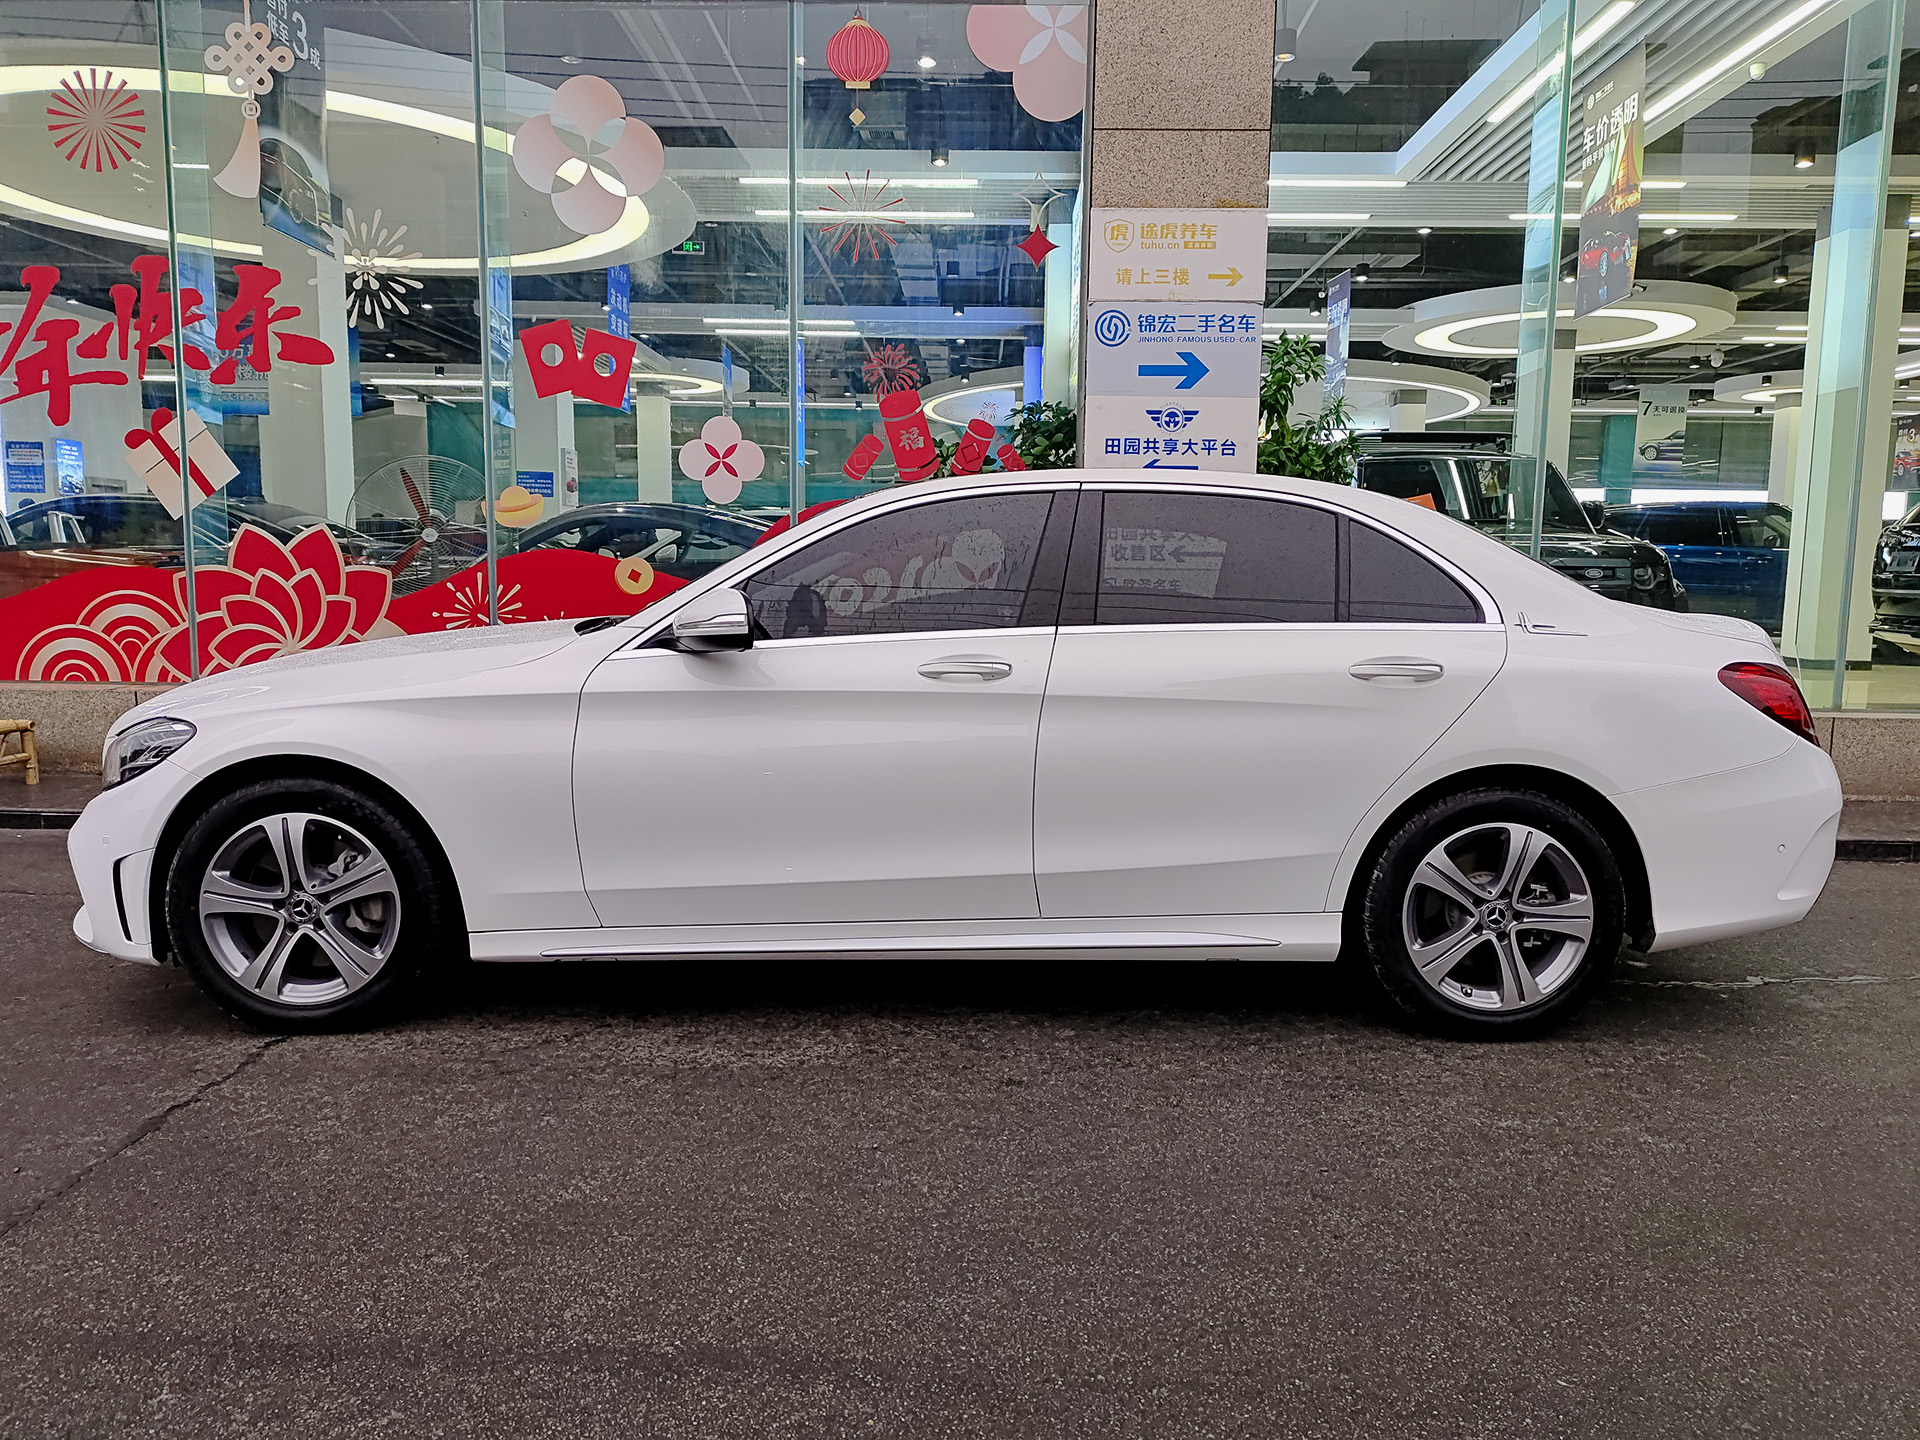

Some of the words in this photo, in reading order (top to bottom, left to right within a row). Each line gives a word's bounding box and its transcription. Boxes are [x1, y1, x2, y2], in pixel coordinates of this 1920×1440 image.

[1583, 92, 1639, 153] 车价透明
[1110, 224, 1128, 241] 虎
[1140, 222, 1218, 240] 途虎养车
[1140, 241, 1180, 250] tuhu.cn
[1115, 267, 1190, 286] 请上三楼
[1137, 314, 1256, 333] 锦宏二手名车
[0, 254, 335, 427] 年快乐
[899, 427, 925, 450] 福
[1104, 437, 1237, 457] 田园共享大平台
